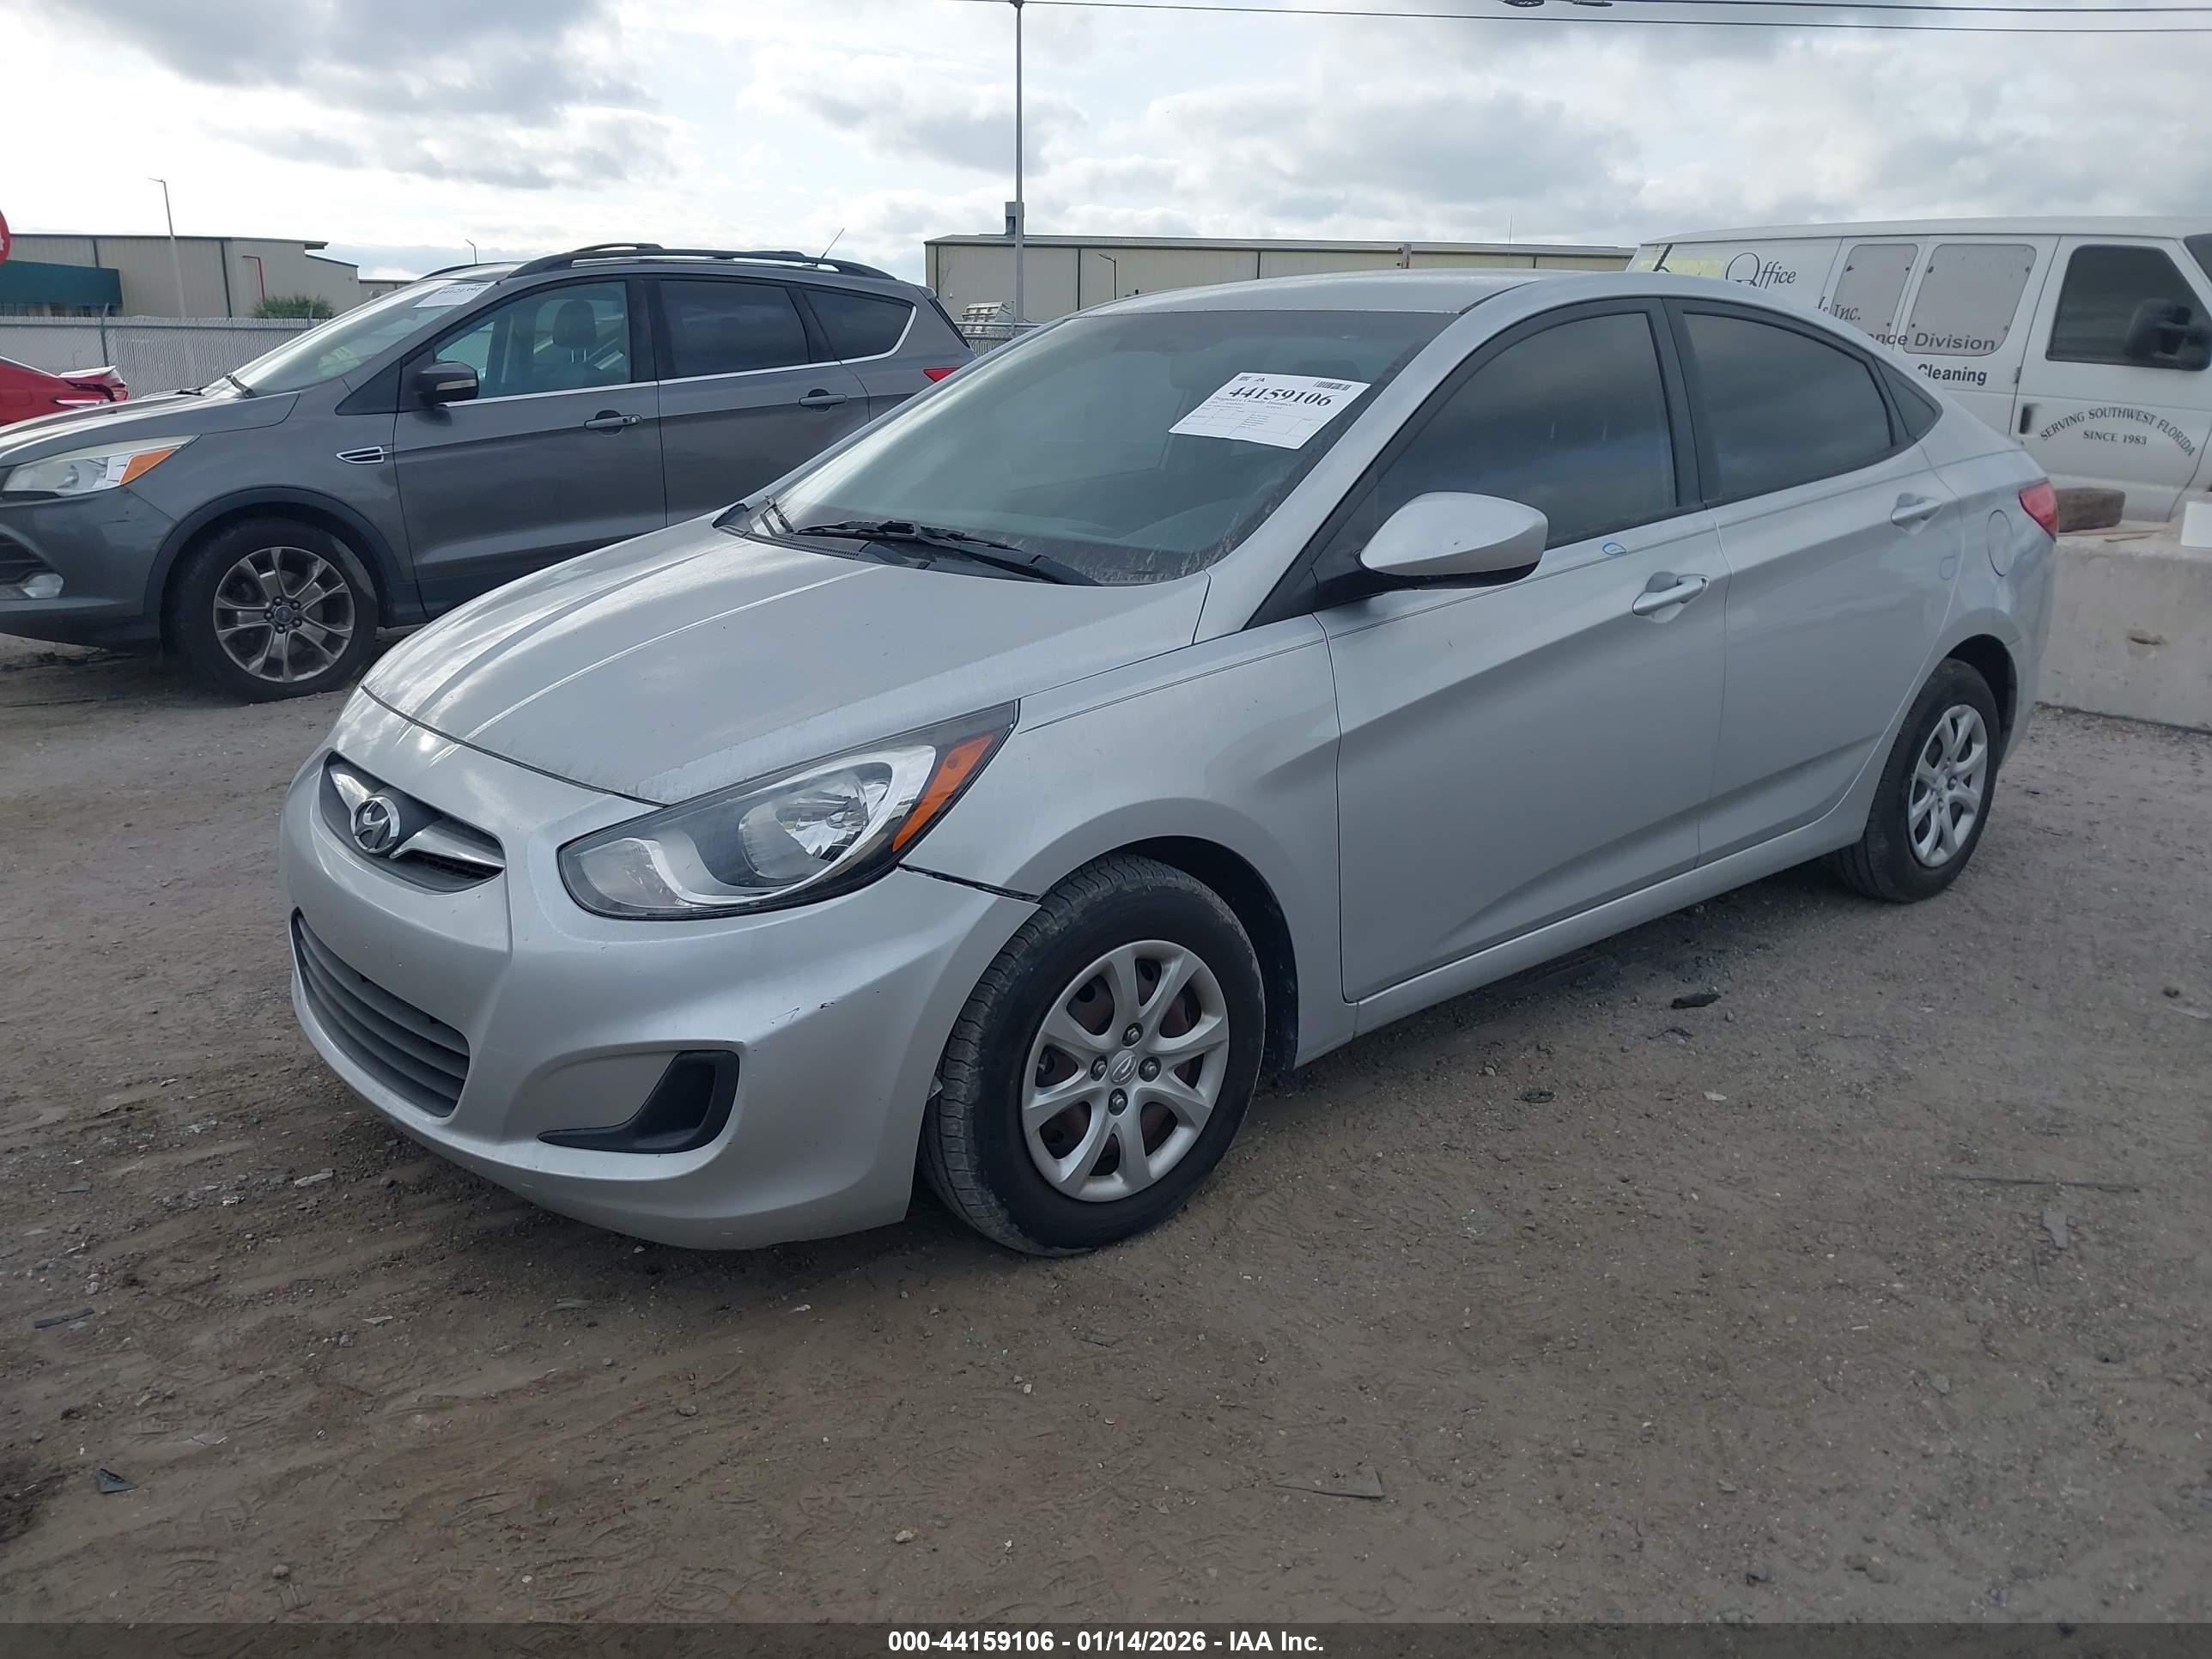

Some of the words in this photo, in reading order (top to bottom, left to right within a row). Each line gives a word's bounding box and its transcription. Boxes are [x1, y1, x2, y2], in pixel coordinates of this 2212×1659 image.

[1727, 252, 1796, 289] Office
[1834, 303, 1861, 321] Inc.
[1914, 331, 1996, 351] Division
[1229, 386, 1338, 407] 44159106
[2040, 411, 2085, 441] SERVING
[2088, 406, 2157, 426] SOUTHWEST
[2156, 418, 2196, 457] FLORIDA
[2082, 430, 2118, 442] SINCE
[2123, 434, 2147, 445] 1983
